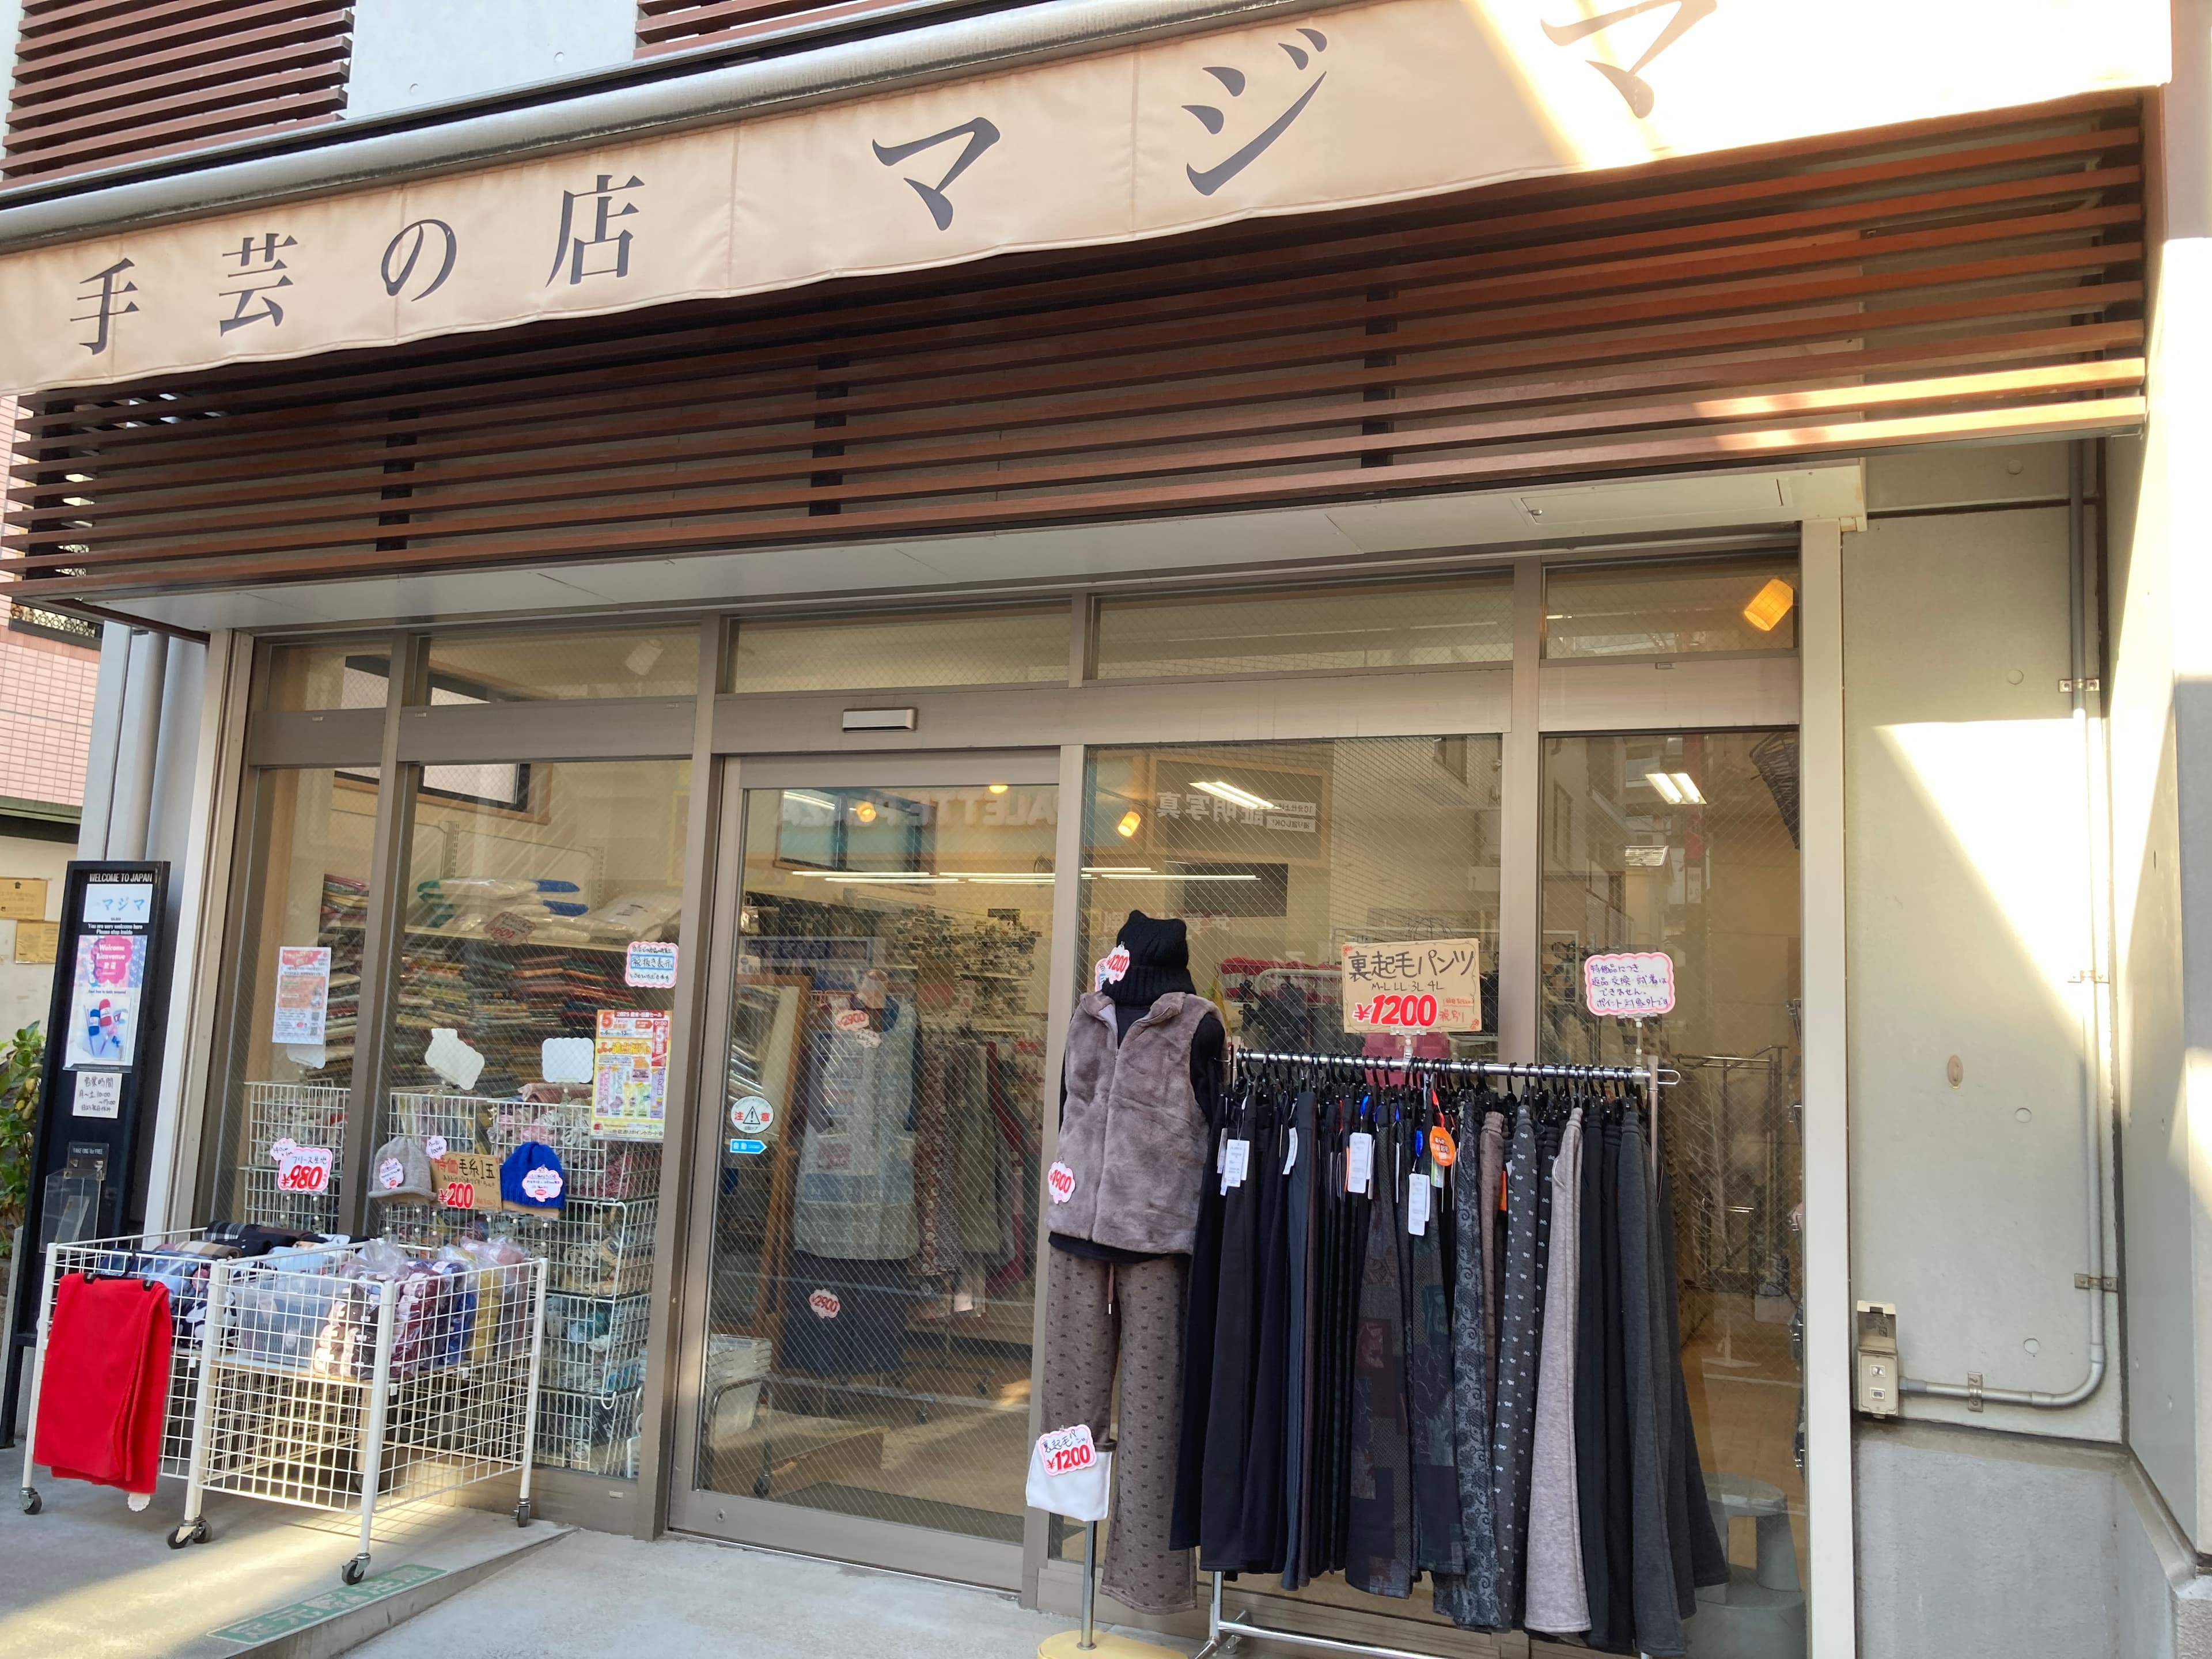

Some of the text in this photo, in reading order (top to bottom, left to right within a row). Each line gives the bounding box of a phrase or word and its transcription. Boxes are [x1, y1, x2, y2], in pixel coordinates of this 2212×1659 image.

[70, 0, 1718, 355] 手芸の店 マジマ
[89, 873, 152, 882] WELCOME TO JAPAN
[102, 897, 145, 911] マジマ
[631, 956, 673, 968] 税抜き表示
[1348, 949, 1474, 982] 裏起毛パンツ
[1590, 964, 1639, 974] 特価品につき
[1354, 994, 1437, 1027] ¥1200
[85, 1076, 113, 1088] 営業時間
[281, 1165, 323, 1189] ¥980
[440, 1183, 474, 1208] ¥200
[1047, 1444, 1090, 1471] ¥1200
